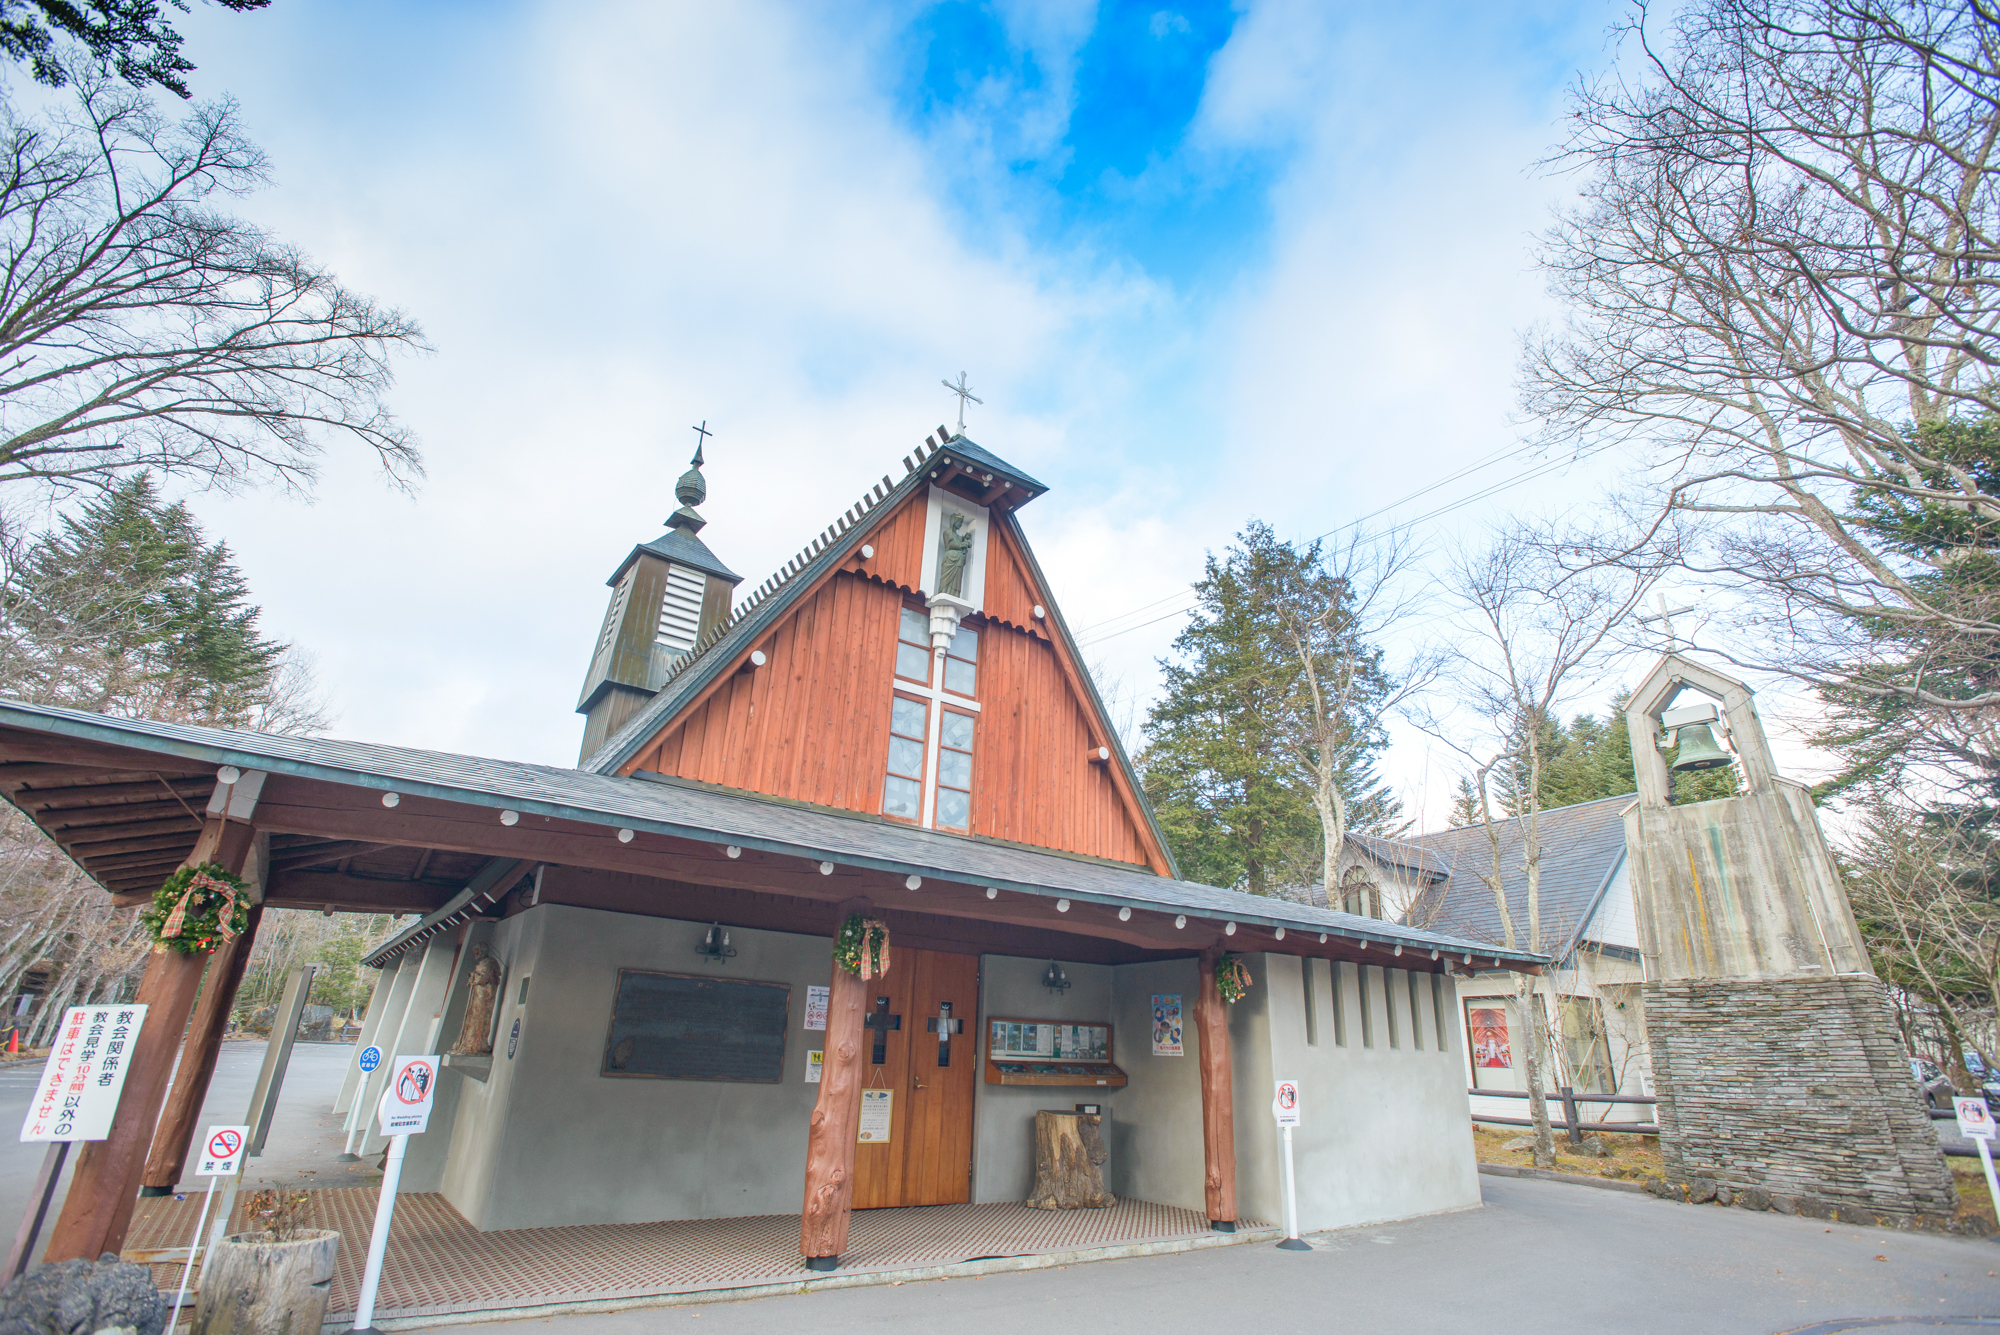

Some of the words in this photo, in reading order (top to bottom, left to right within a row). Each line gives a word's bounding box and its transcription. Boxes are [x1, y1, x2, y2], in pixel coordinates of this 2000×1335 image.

[29, 1011, 87, 1135] 駐車はできません
[97, 1011, 135, 1087] 教会関係者
[203, 1161, 233, 1171] 禁煙
